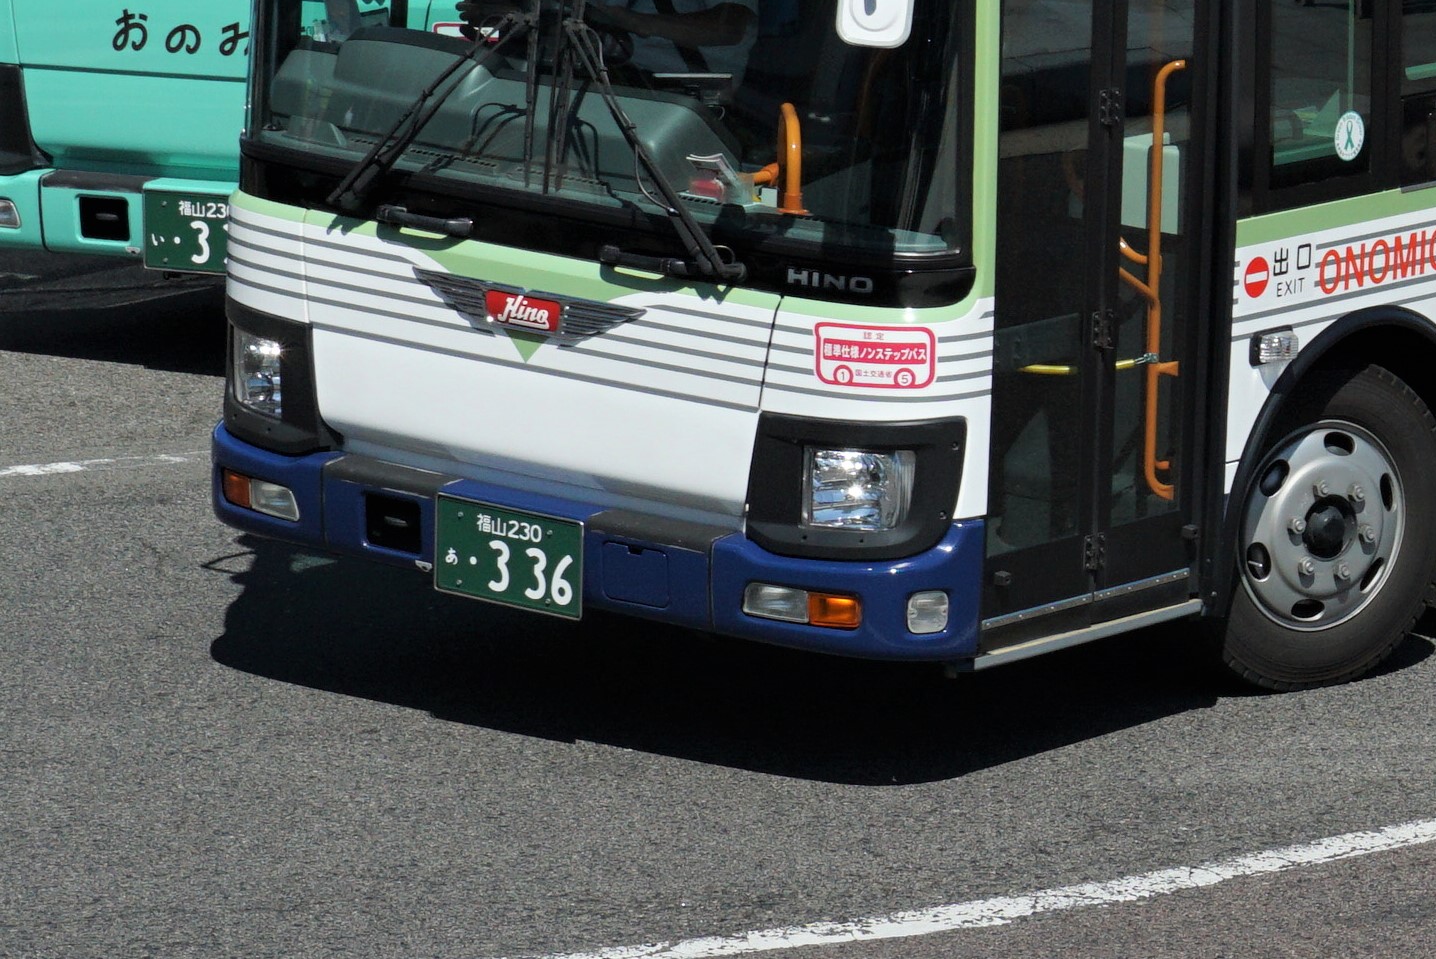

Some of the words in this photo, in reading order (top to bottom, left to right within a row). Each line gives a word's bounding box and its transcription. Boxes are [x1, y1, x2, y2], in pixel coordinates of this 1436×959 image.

[1273, 243, 1312, 276] 出口
[787, 267, 874, 294] HINO
[1276, 277, 1306, 298] EXIT
[497, 295, 550, 331] Hino
[823, 343, 927, 361] 標準仕様ノンステップバス
[476, 513, 542, 544] 福山230
